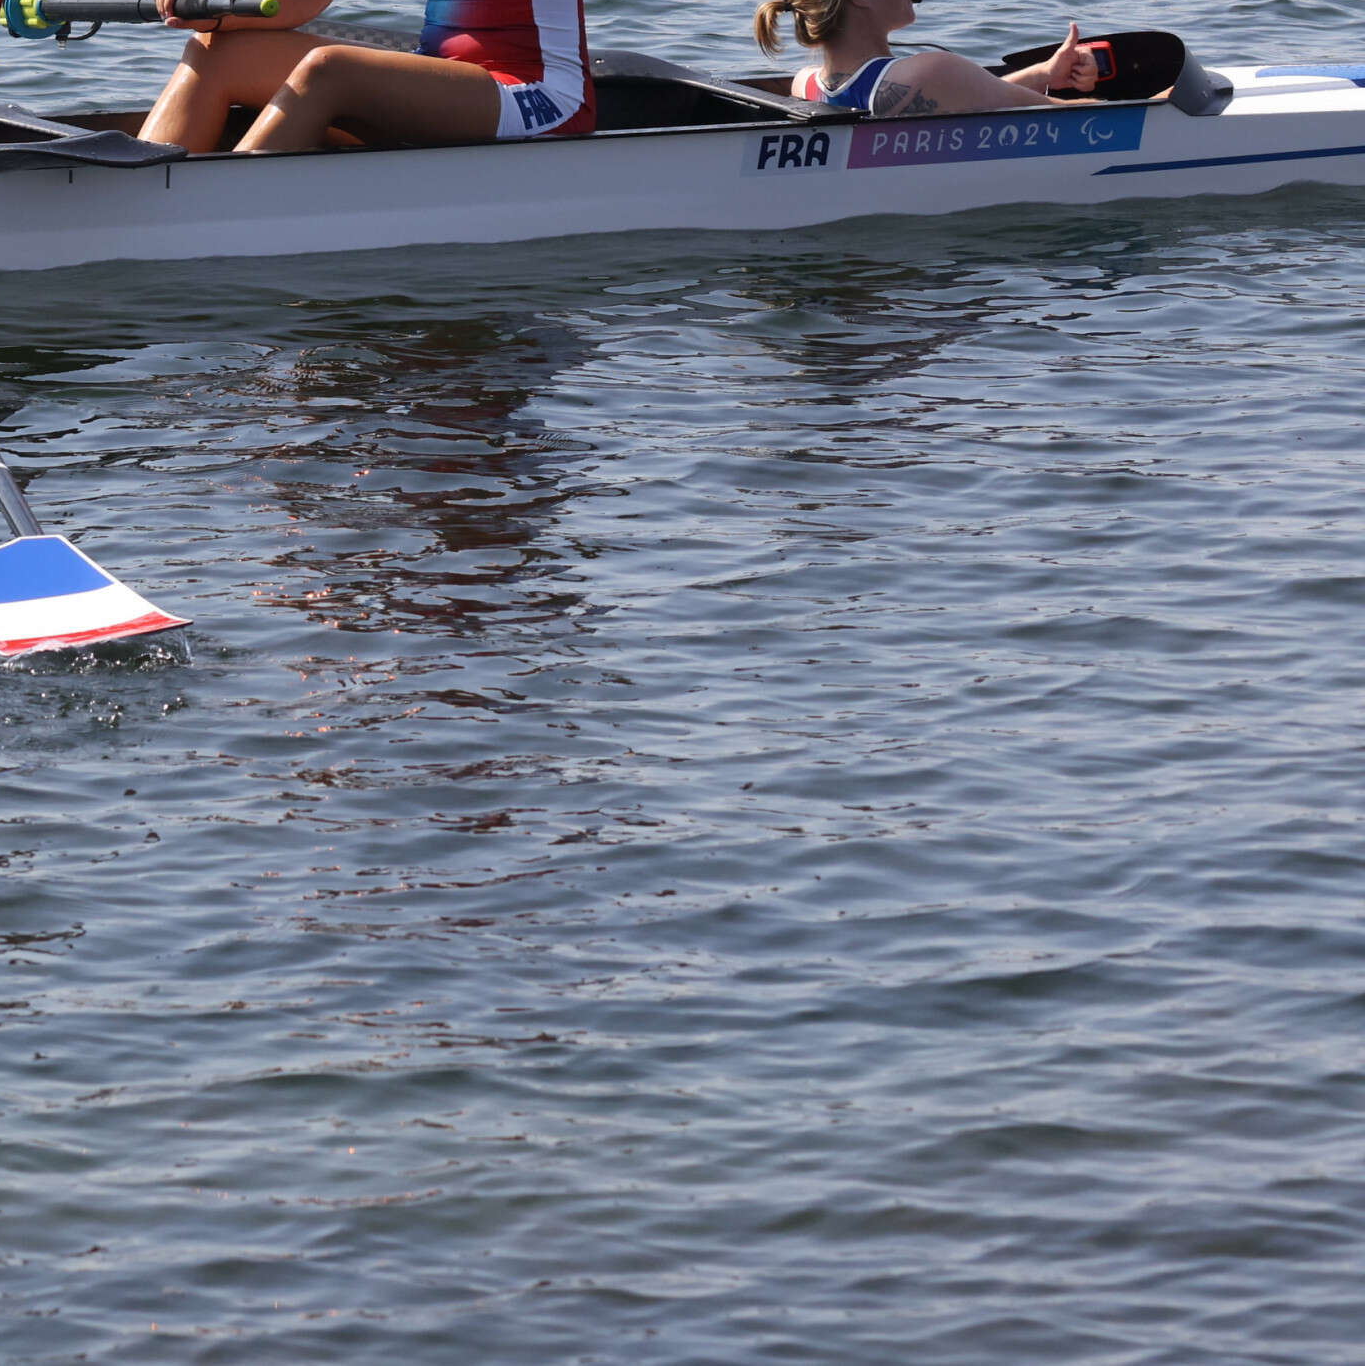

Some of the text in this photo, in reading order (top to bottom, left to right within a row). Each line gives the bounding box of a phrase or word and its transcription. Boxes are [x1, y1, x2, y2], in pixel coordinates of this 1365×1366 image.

[512, 88, 563, 131] FRA
[756, 131, 831, 170] FRA
[871, 121, 1060, 155] PARIS 2024
